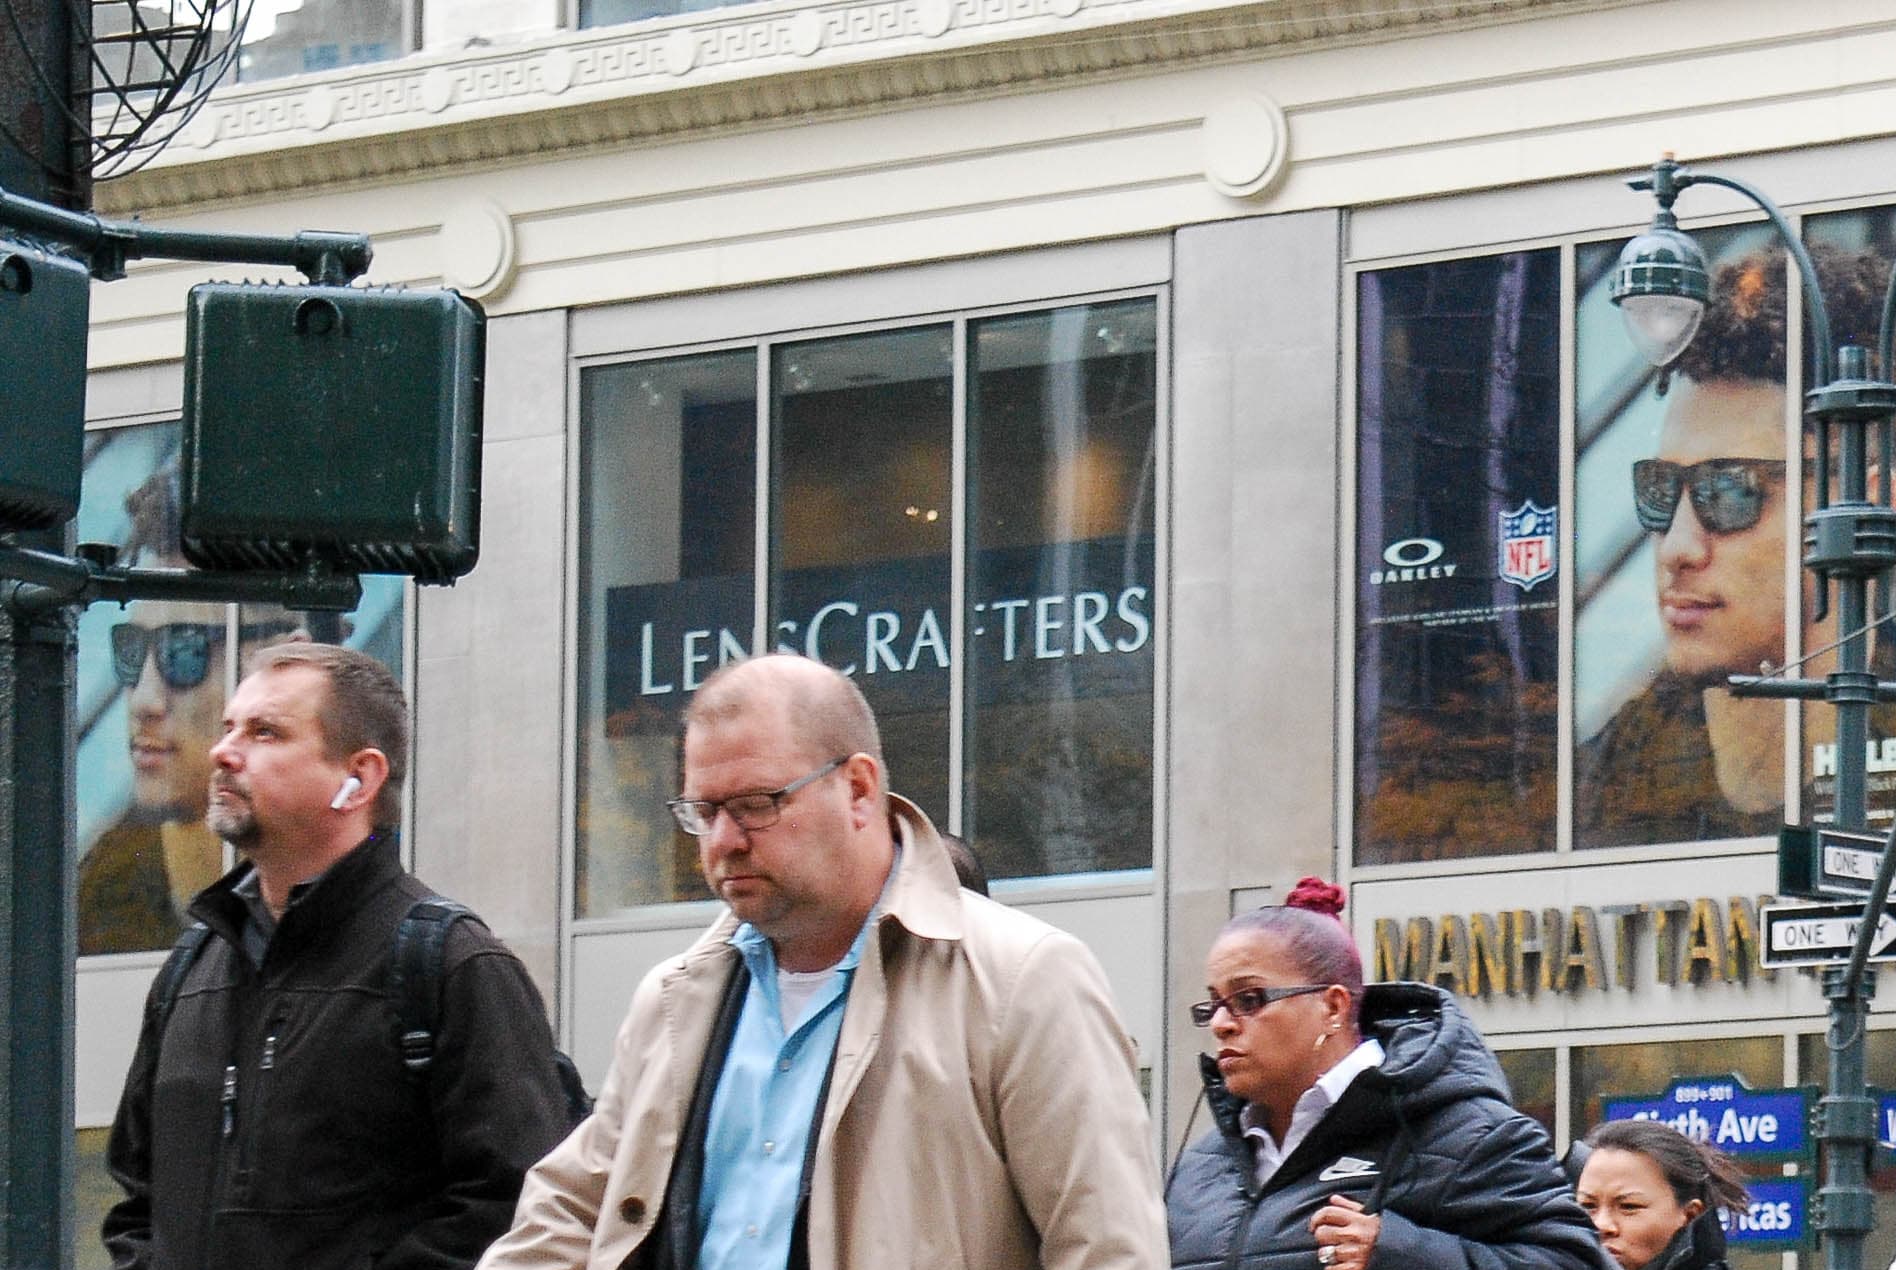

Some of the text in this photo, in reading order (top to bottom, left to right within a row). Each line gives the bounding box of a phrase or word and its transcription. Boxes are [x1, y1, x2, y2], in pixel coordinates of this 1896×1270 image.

[1508, 540, 1551, 576] NFL
[640, 585, 1149, 695] LENCRATERS
[1832, 852, 1859, 874] ONE
[1375, 896, 1775, 1000] MANHATTAN
[1784, 920, 1889, 947] ONE WY
[1716, 1108, 1778, 1143] Ave
